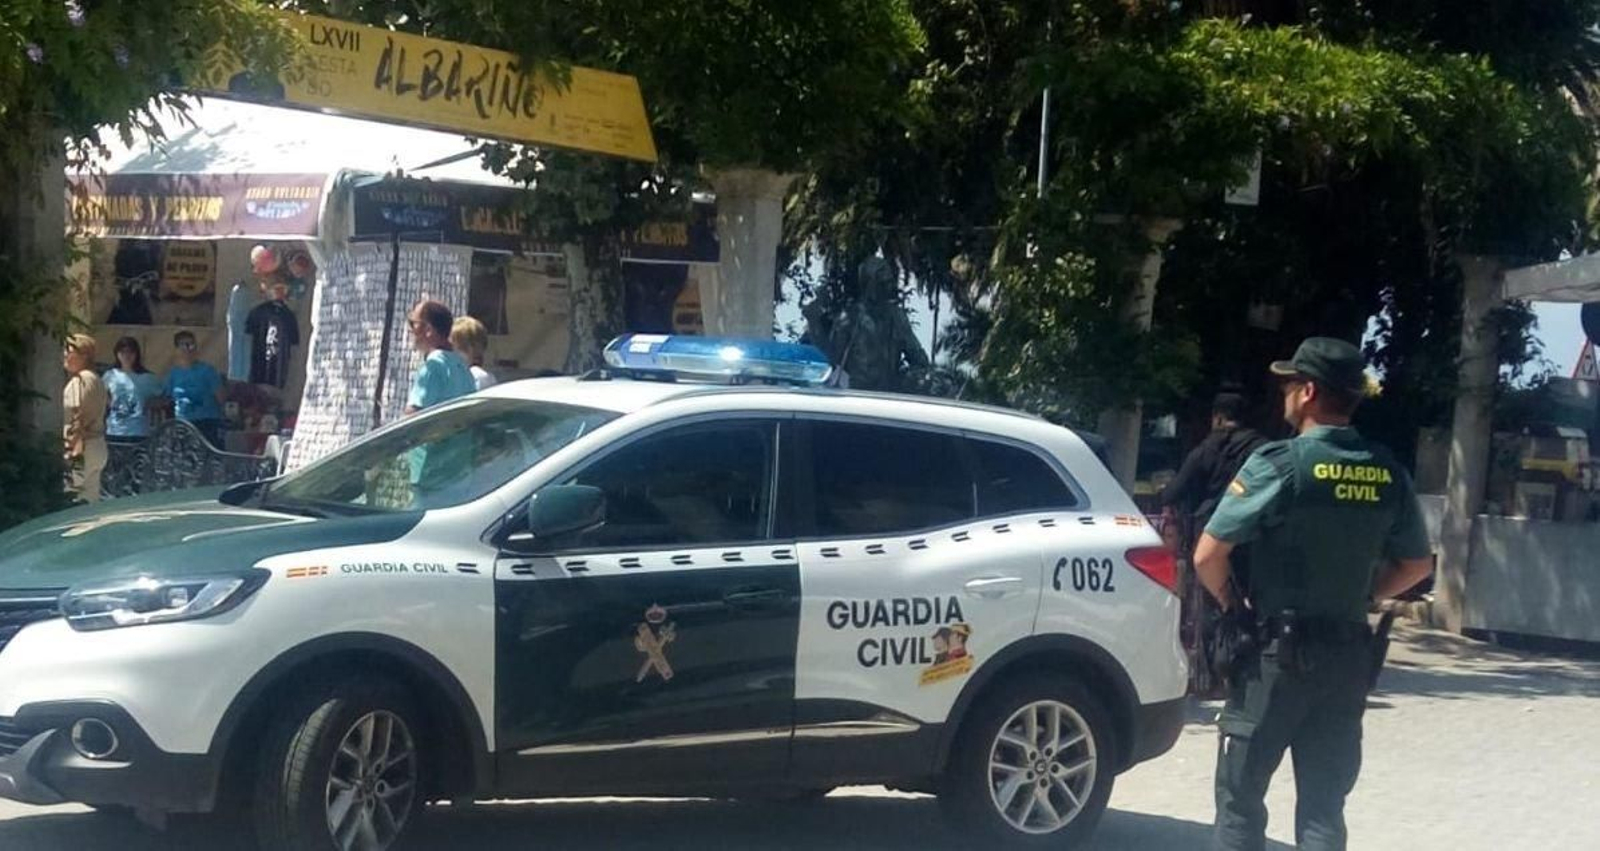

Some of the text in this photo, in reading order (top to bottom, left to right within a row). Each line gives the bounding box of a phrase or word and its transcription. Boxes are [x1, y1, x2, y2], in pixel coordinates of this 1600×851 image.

[311, 22, 360, 52] LXVII
[374, 36, 545, 120] ALBARIÑO
[1313, 463, 1393, 484] GUARDIA
[1334, 484, 1381, 502] CIVIL
[340, 562, 449, 574] GUARDIA CIVIL
[1072, 557, 1115, 592] 062
[826, 595, 964, 630] GUARDIA
[857, 637, 932, 668] CIVIL
